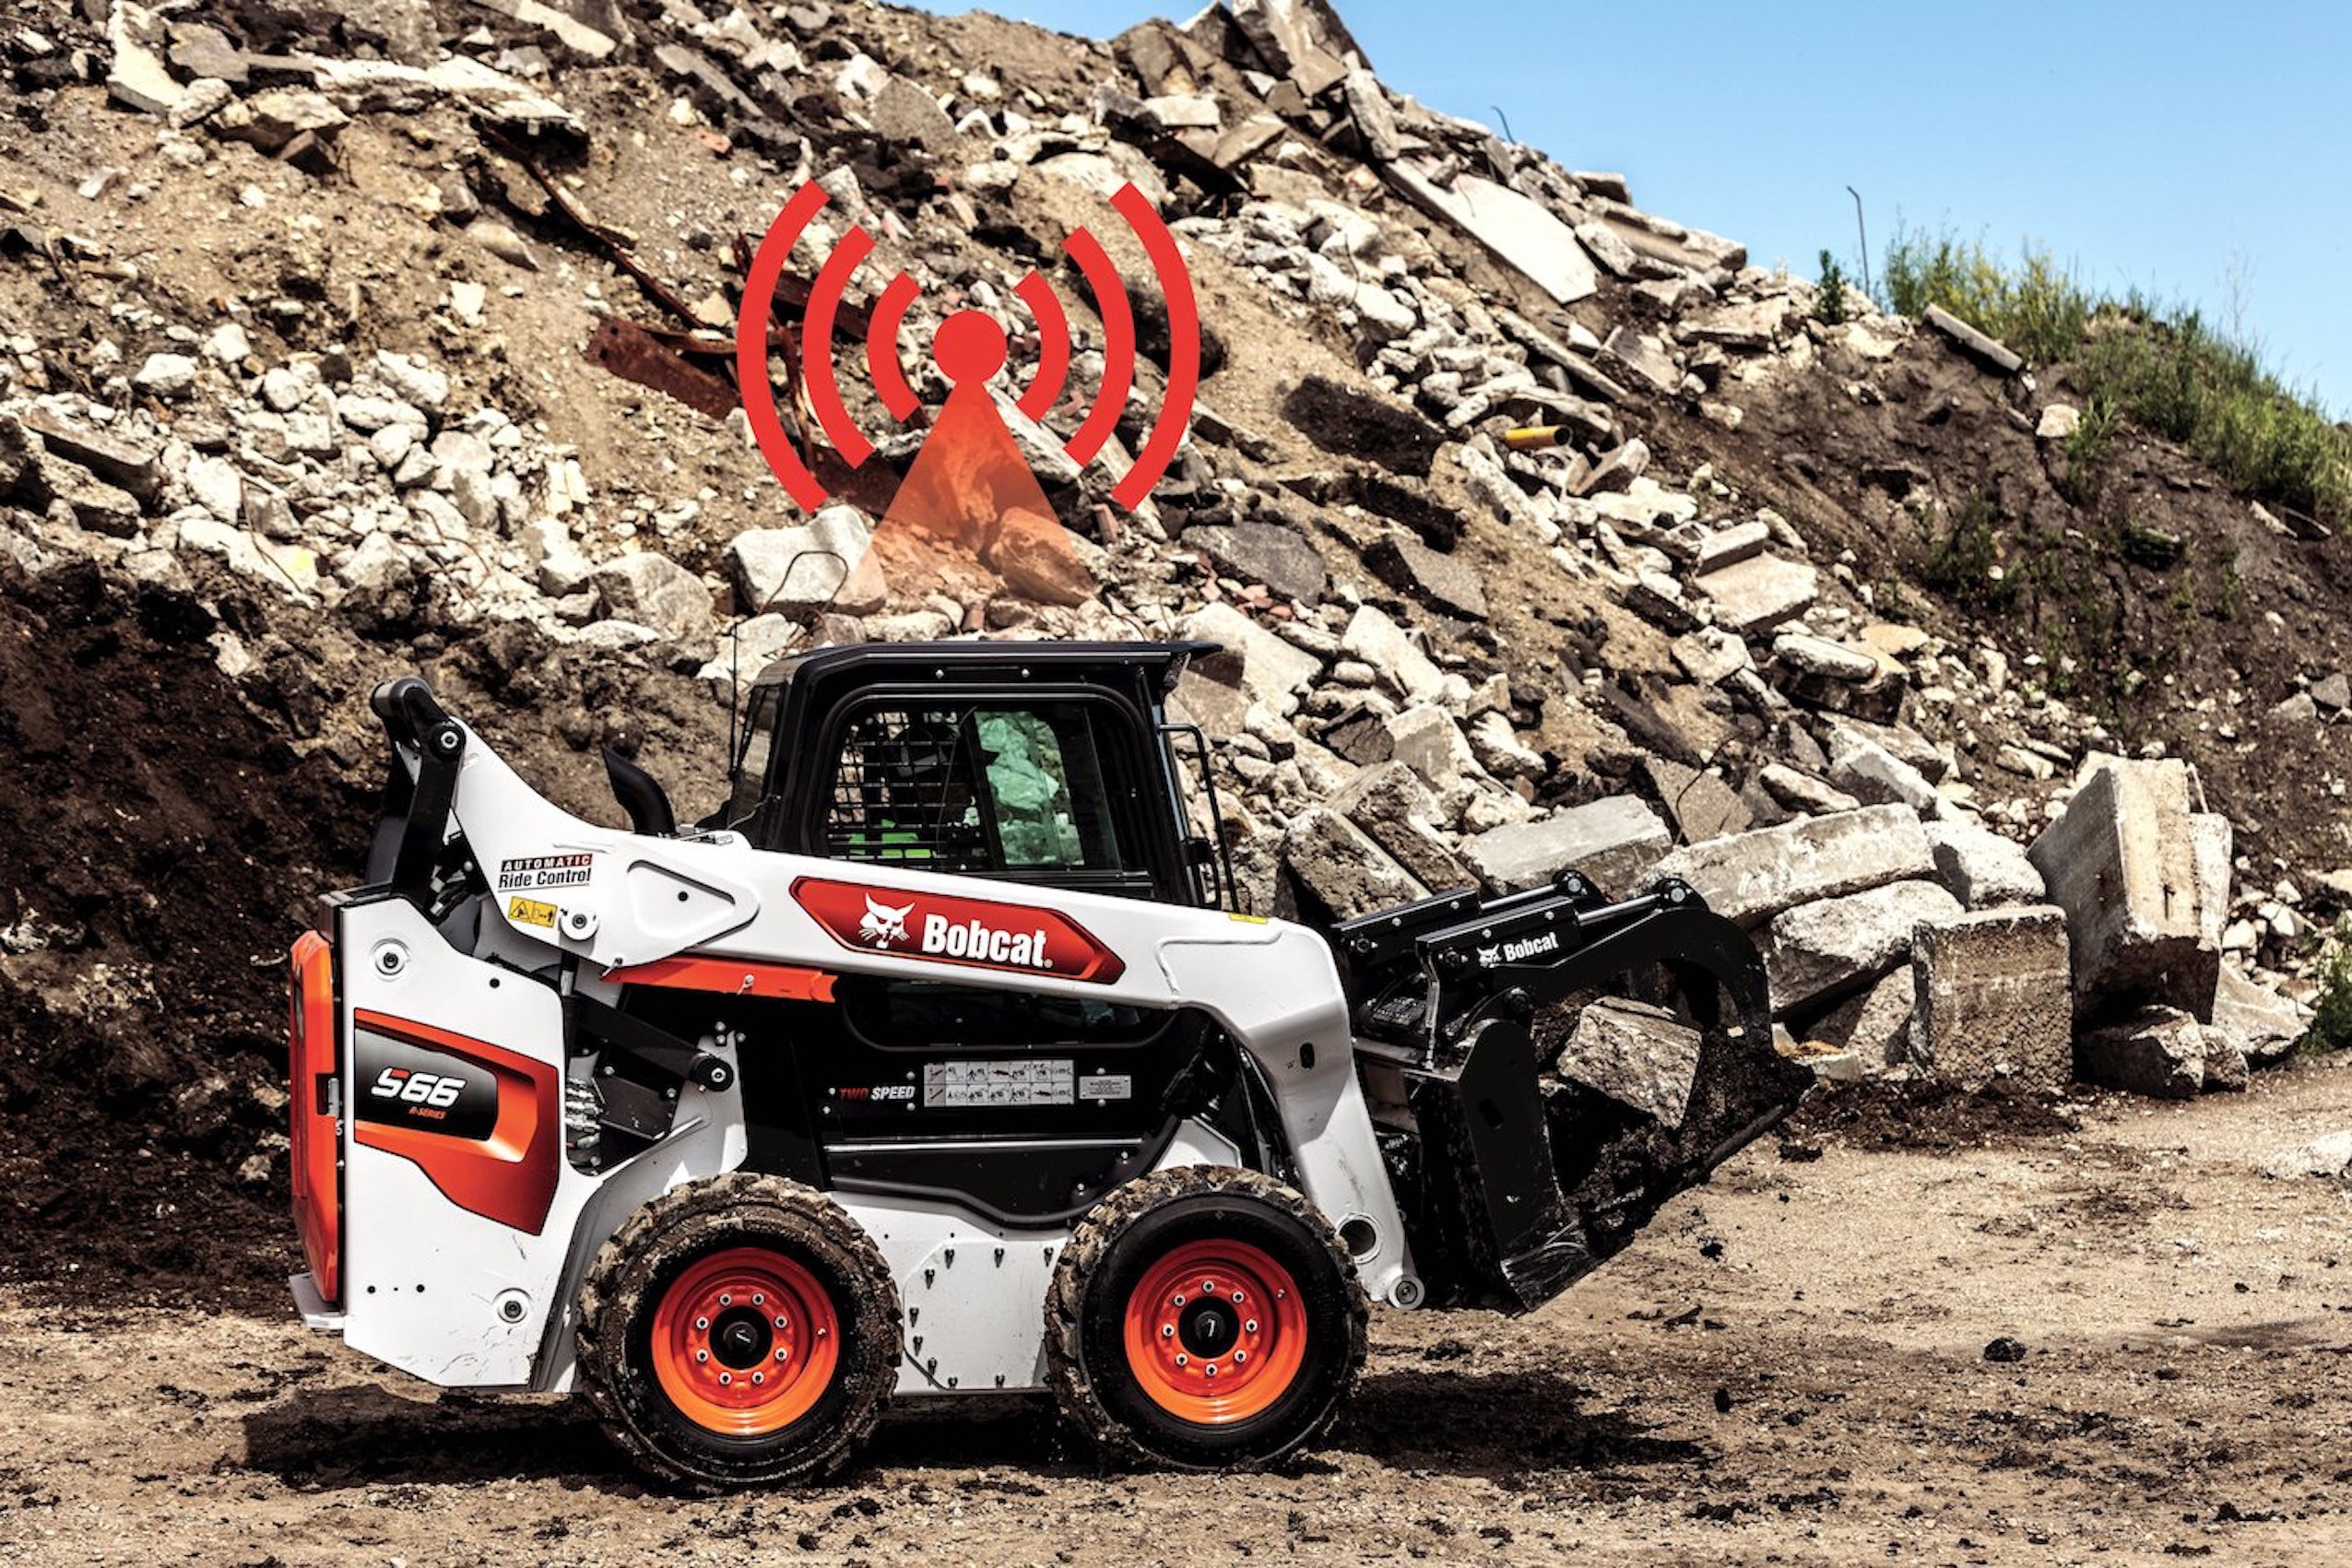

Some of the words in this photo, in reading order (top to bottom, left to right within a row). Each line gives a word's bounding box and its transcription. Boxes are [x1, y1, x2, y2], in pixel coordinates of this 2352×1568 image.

[503, 855, 591, 872] AUTOMATIC
[499, 874, 532, 888] Ride
[537, 867, 591, 885] Control
[1503, 932, 1559, 961] Bobcat
[371, 1067, 467, 1107] S66
[840, 1088, 869, 1101] TWO
[870, 1086, 916, 1101] SPEED
